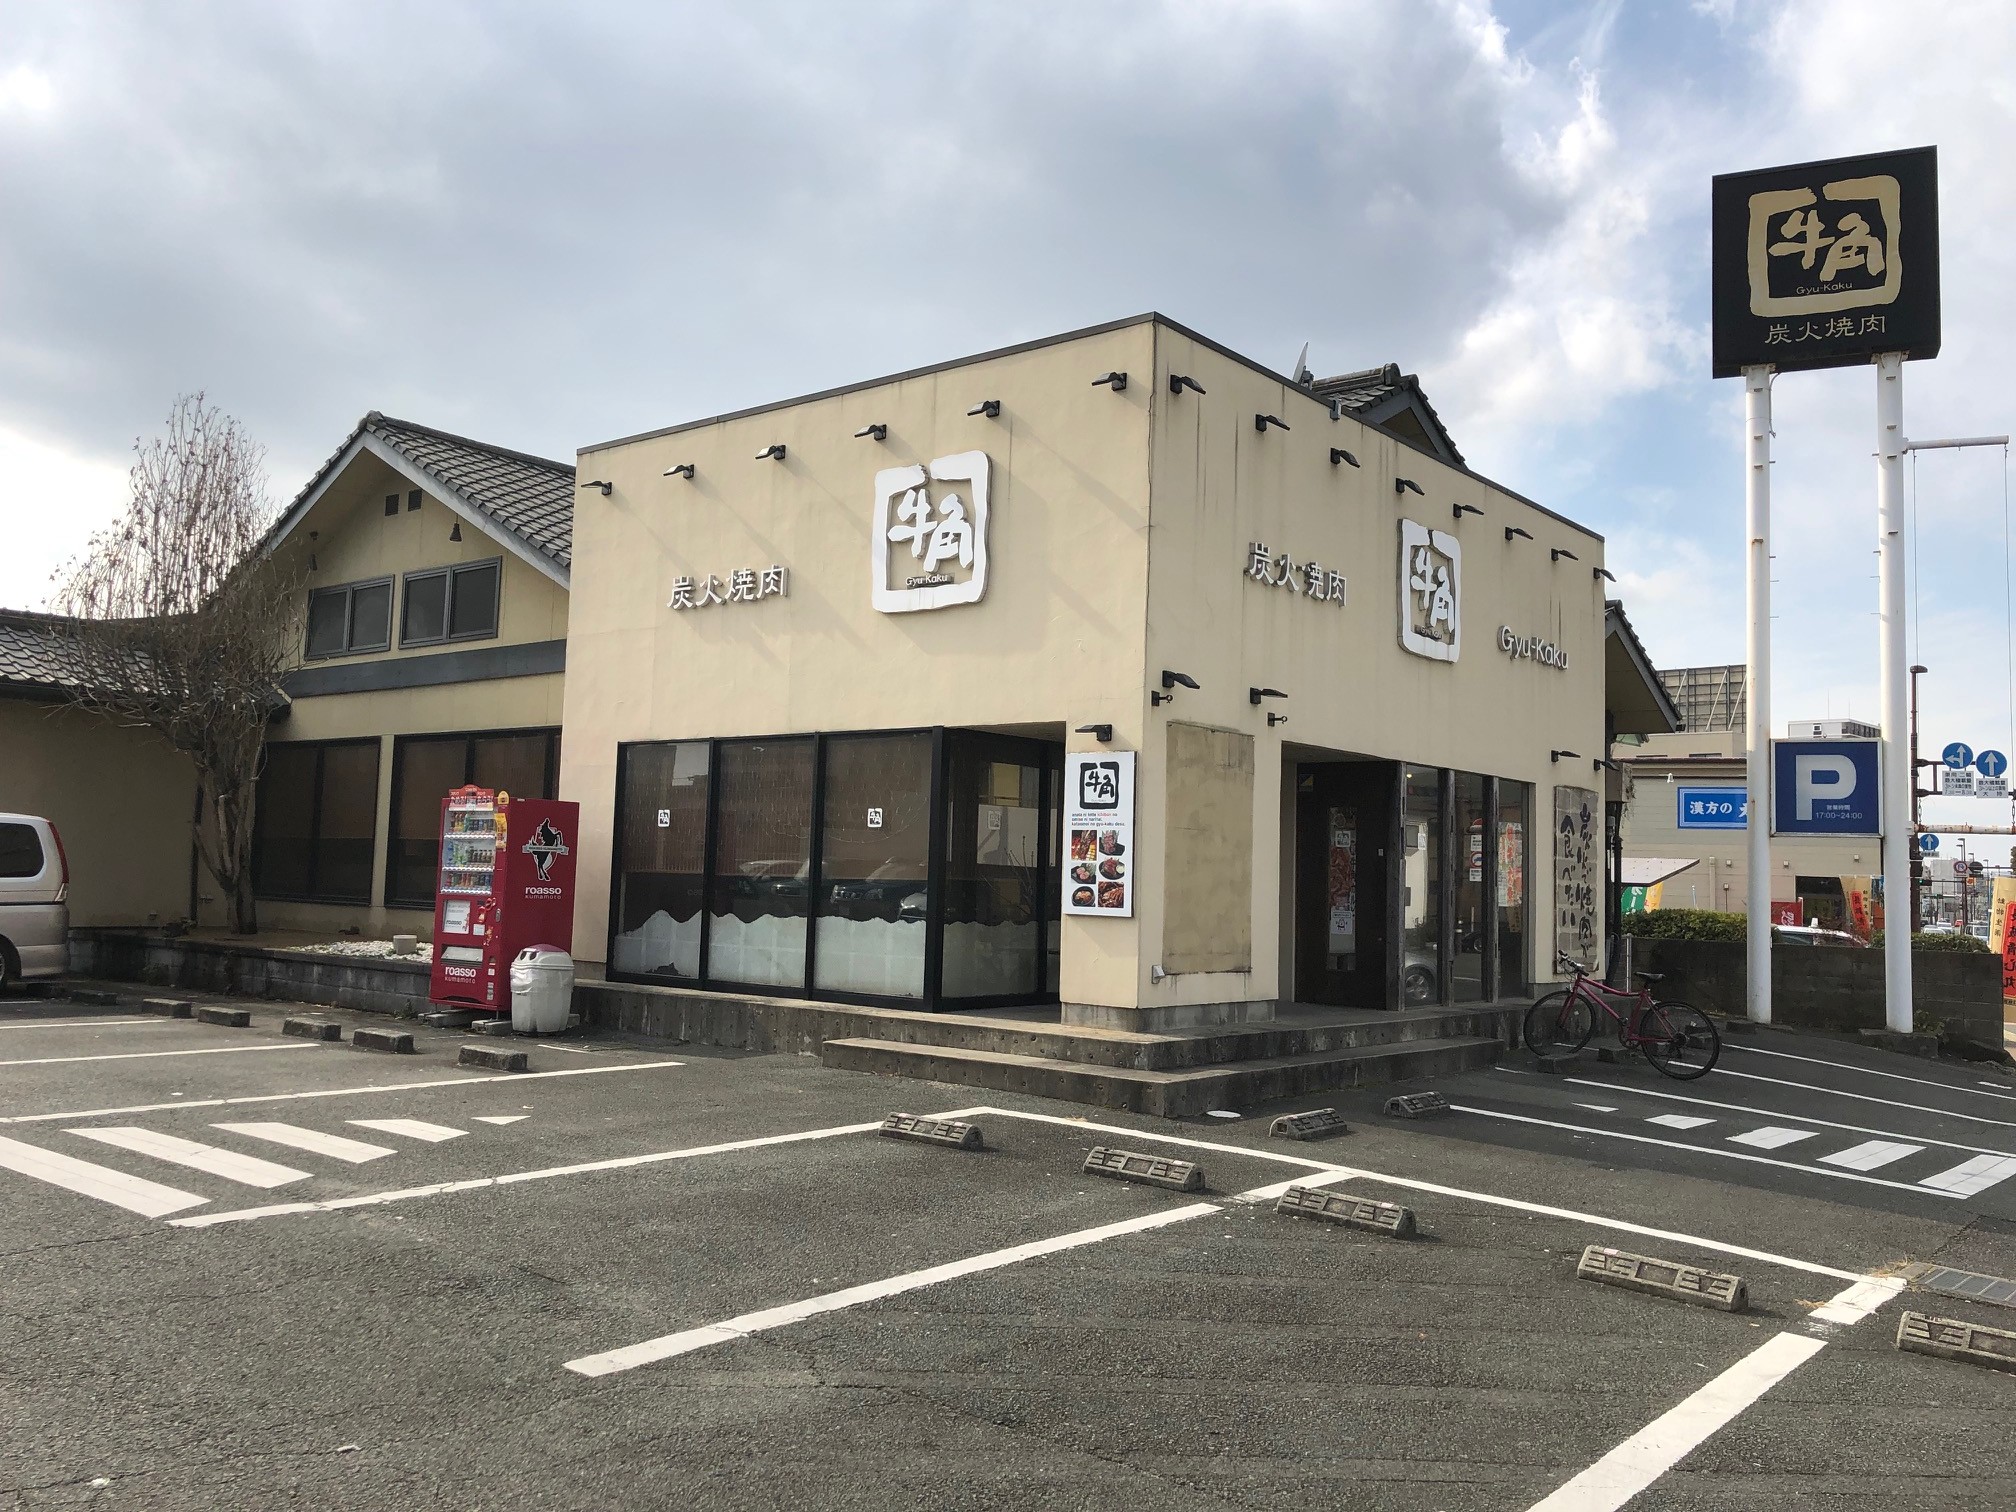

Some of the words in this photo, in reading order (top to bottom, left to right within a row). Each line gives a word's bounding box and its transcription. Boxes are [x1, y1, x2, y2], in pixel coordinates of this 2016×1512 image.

[1769, 209, 1886, 282] 牛角
[1796, 281, 1853, 295] Gyu-Kaku
[1765, 313, 1886, 345] 炭火焼肉
[888, 488, 974, 573] 牛角
[667, 564, 789, 610] 炭火焼肉
[1410, 548, 1455, 633] 牛角
[1500, 625, 1569, 669] Gyu-Kaku
[1085, 771, 1115, 798] 牛角
[1796, 754, 1857, 820] P
[1689, 801, 1733, 815] 漢方の
[525, 886, 562, 895] roasso
[445, 966, 477, 977] roasso
